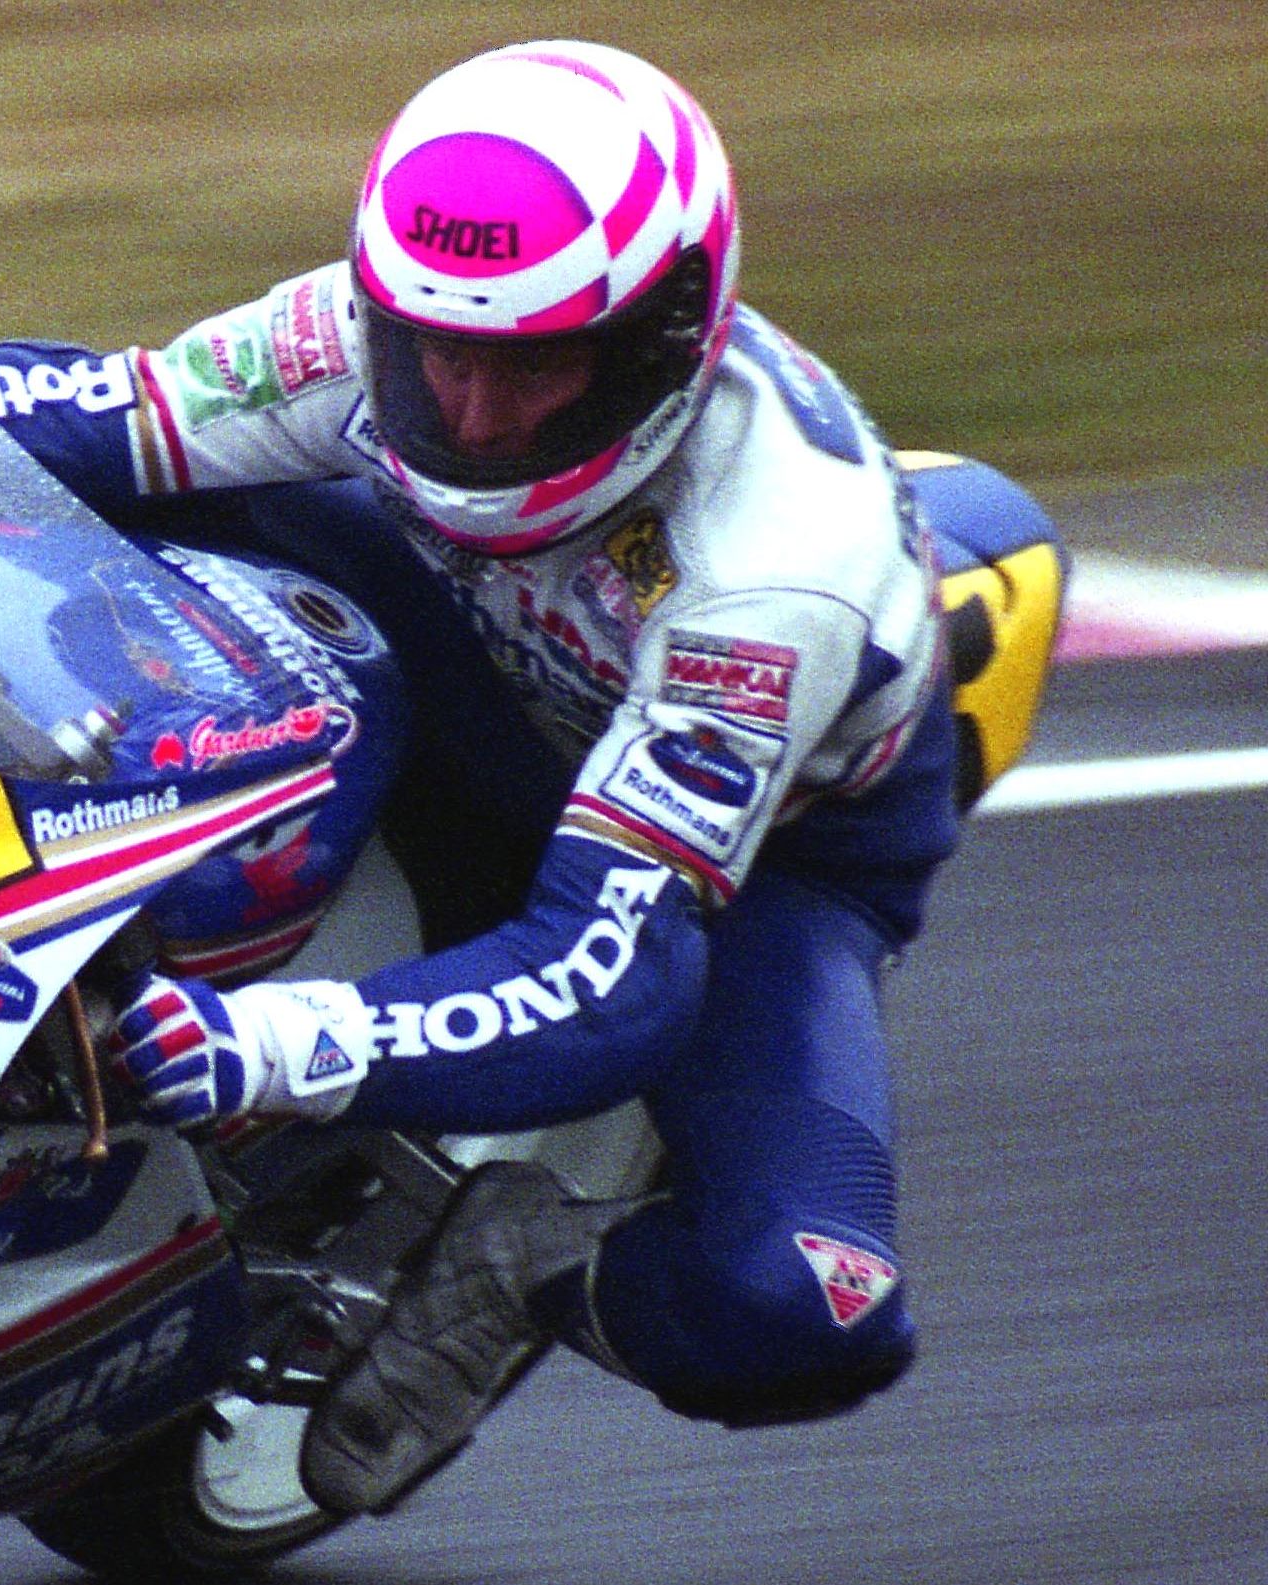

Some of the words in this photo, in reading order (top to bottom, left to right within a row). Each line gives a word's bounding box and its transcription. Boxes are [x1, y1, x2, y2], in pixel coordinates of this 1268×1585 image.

[407, 205, 519, 260] SHOEI
[32, 786, 180, 843] Rothmans
[622, 767, 730, 847] Rothmans
[366, 866, 673, 1060] HONDA
